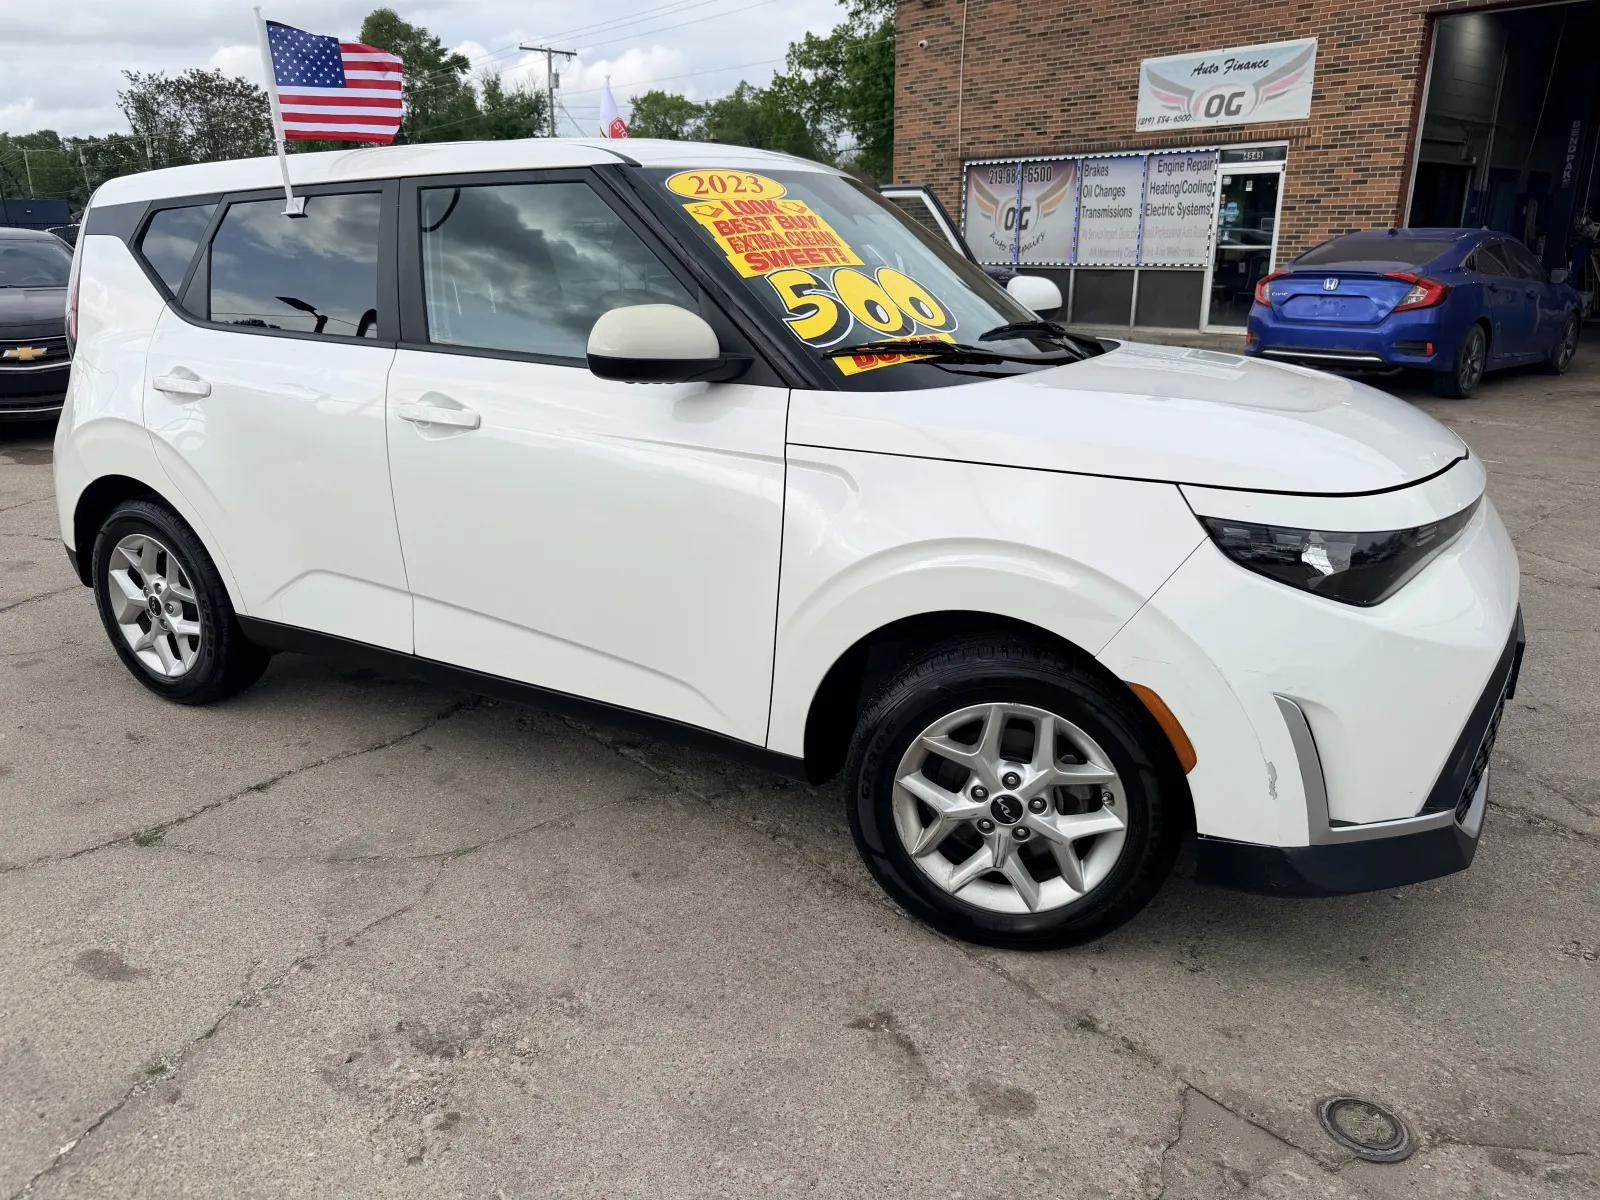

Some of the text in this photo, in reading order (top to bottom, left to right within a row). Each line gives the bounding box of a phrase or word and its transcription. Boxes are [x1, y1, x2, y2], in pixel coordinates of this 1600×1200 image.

[1190, 58, 1270, 77] Auto Finance
[1204, 91, 1246, 118] OG
[614, 121, 628, 138] STO
[988, 166, 1053, 184] 219-88-6500
[1084, 164, 1109, 177] Brakes
[1157, 157, 1214, 176] Engine Repair
[688, 174, 764, 196] 2023
[1082, 184, 1126, 200] Oil Changes
[1150, 180, 1213, 198] Heating/Cooling
[720, 200, 785, 216] LOOK
[1082, 205, 1132, 219] Transmissions
[1145, 203, 1175, 217] Electric
[1176, 202, 1211, 219] Systems
[713, 214, 823, 237] BEST BUY
[1004, 206, 1031, 231] OG
[727, 231, 843, 254] EXTRA CLEAN
[988, 232, 1007, 251] Auto
[744, 248, 850, 272] SWEET!
[766, 267, 958, 347] 500
[851, 336, 941, 369] DO
